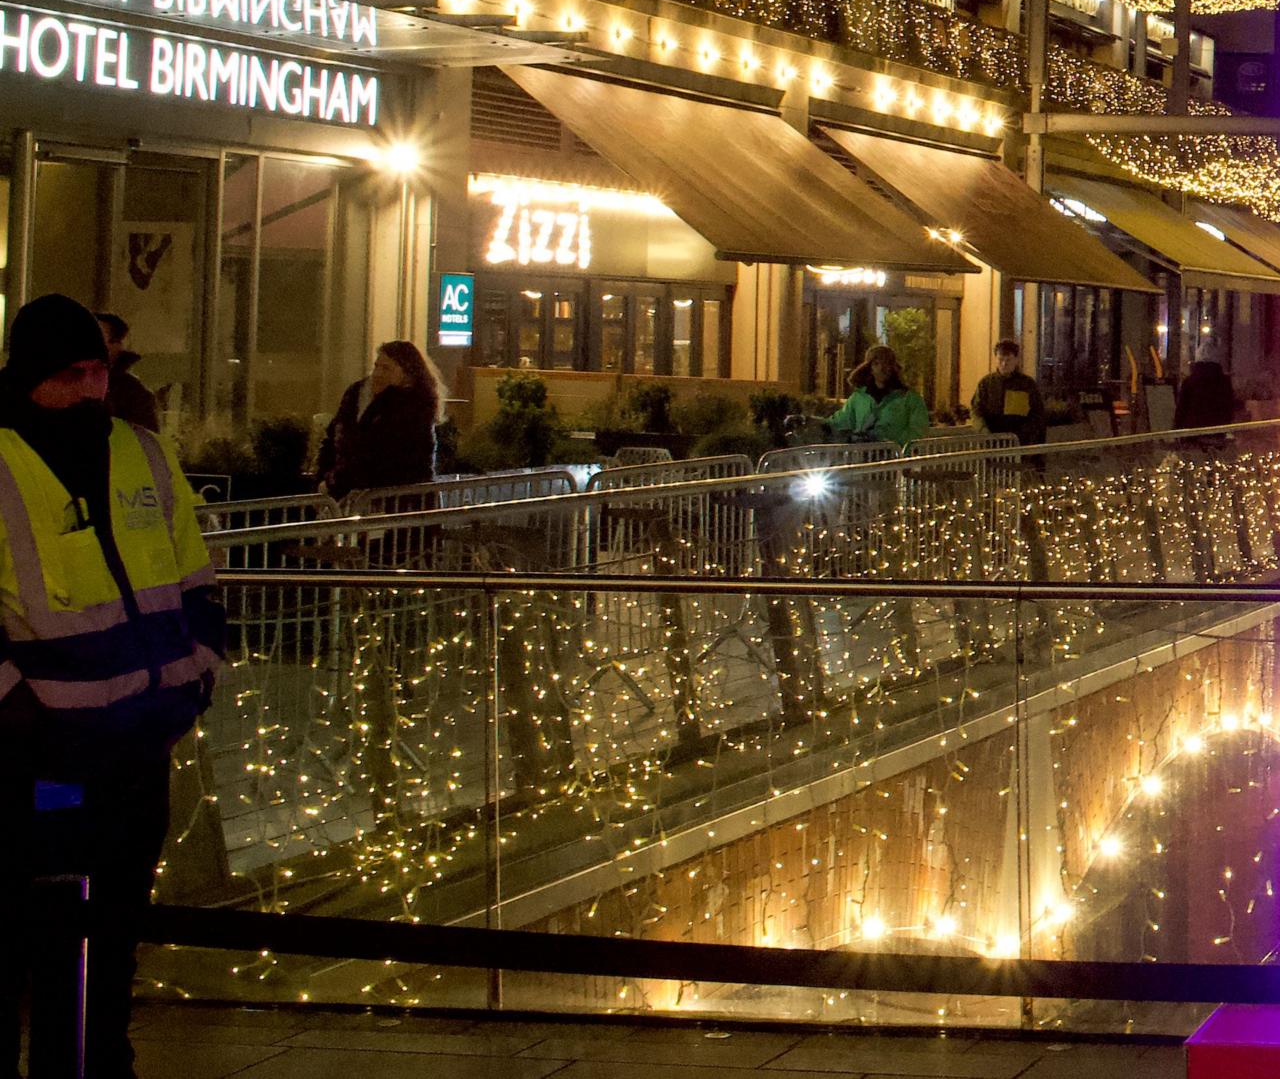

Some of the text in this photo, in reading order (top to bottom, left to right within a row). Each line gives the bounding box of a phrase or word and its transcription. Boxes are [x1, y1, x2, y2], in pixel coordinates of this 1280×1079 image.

[0, 9, 378, 125] HOTEL BIRMINGHAM
[442, 283, 469, 312] AC
